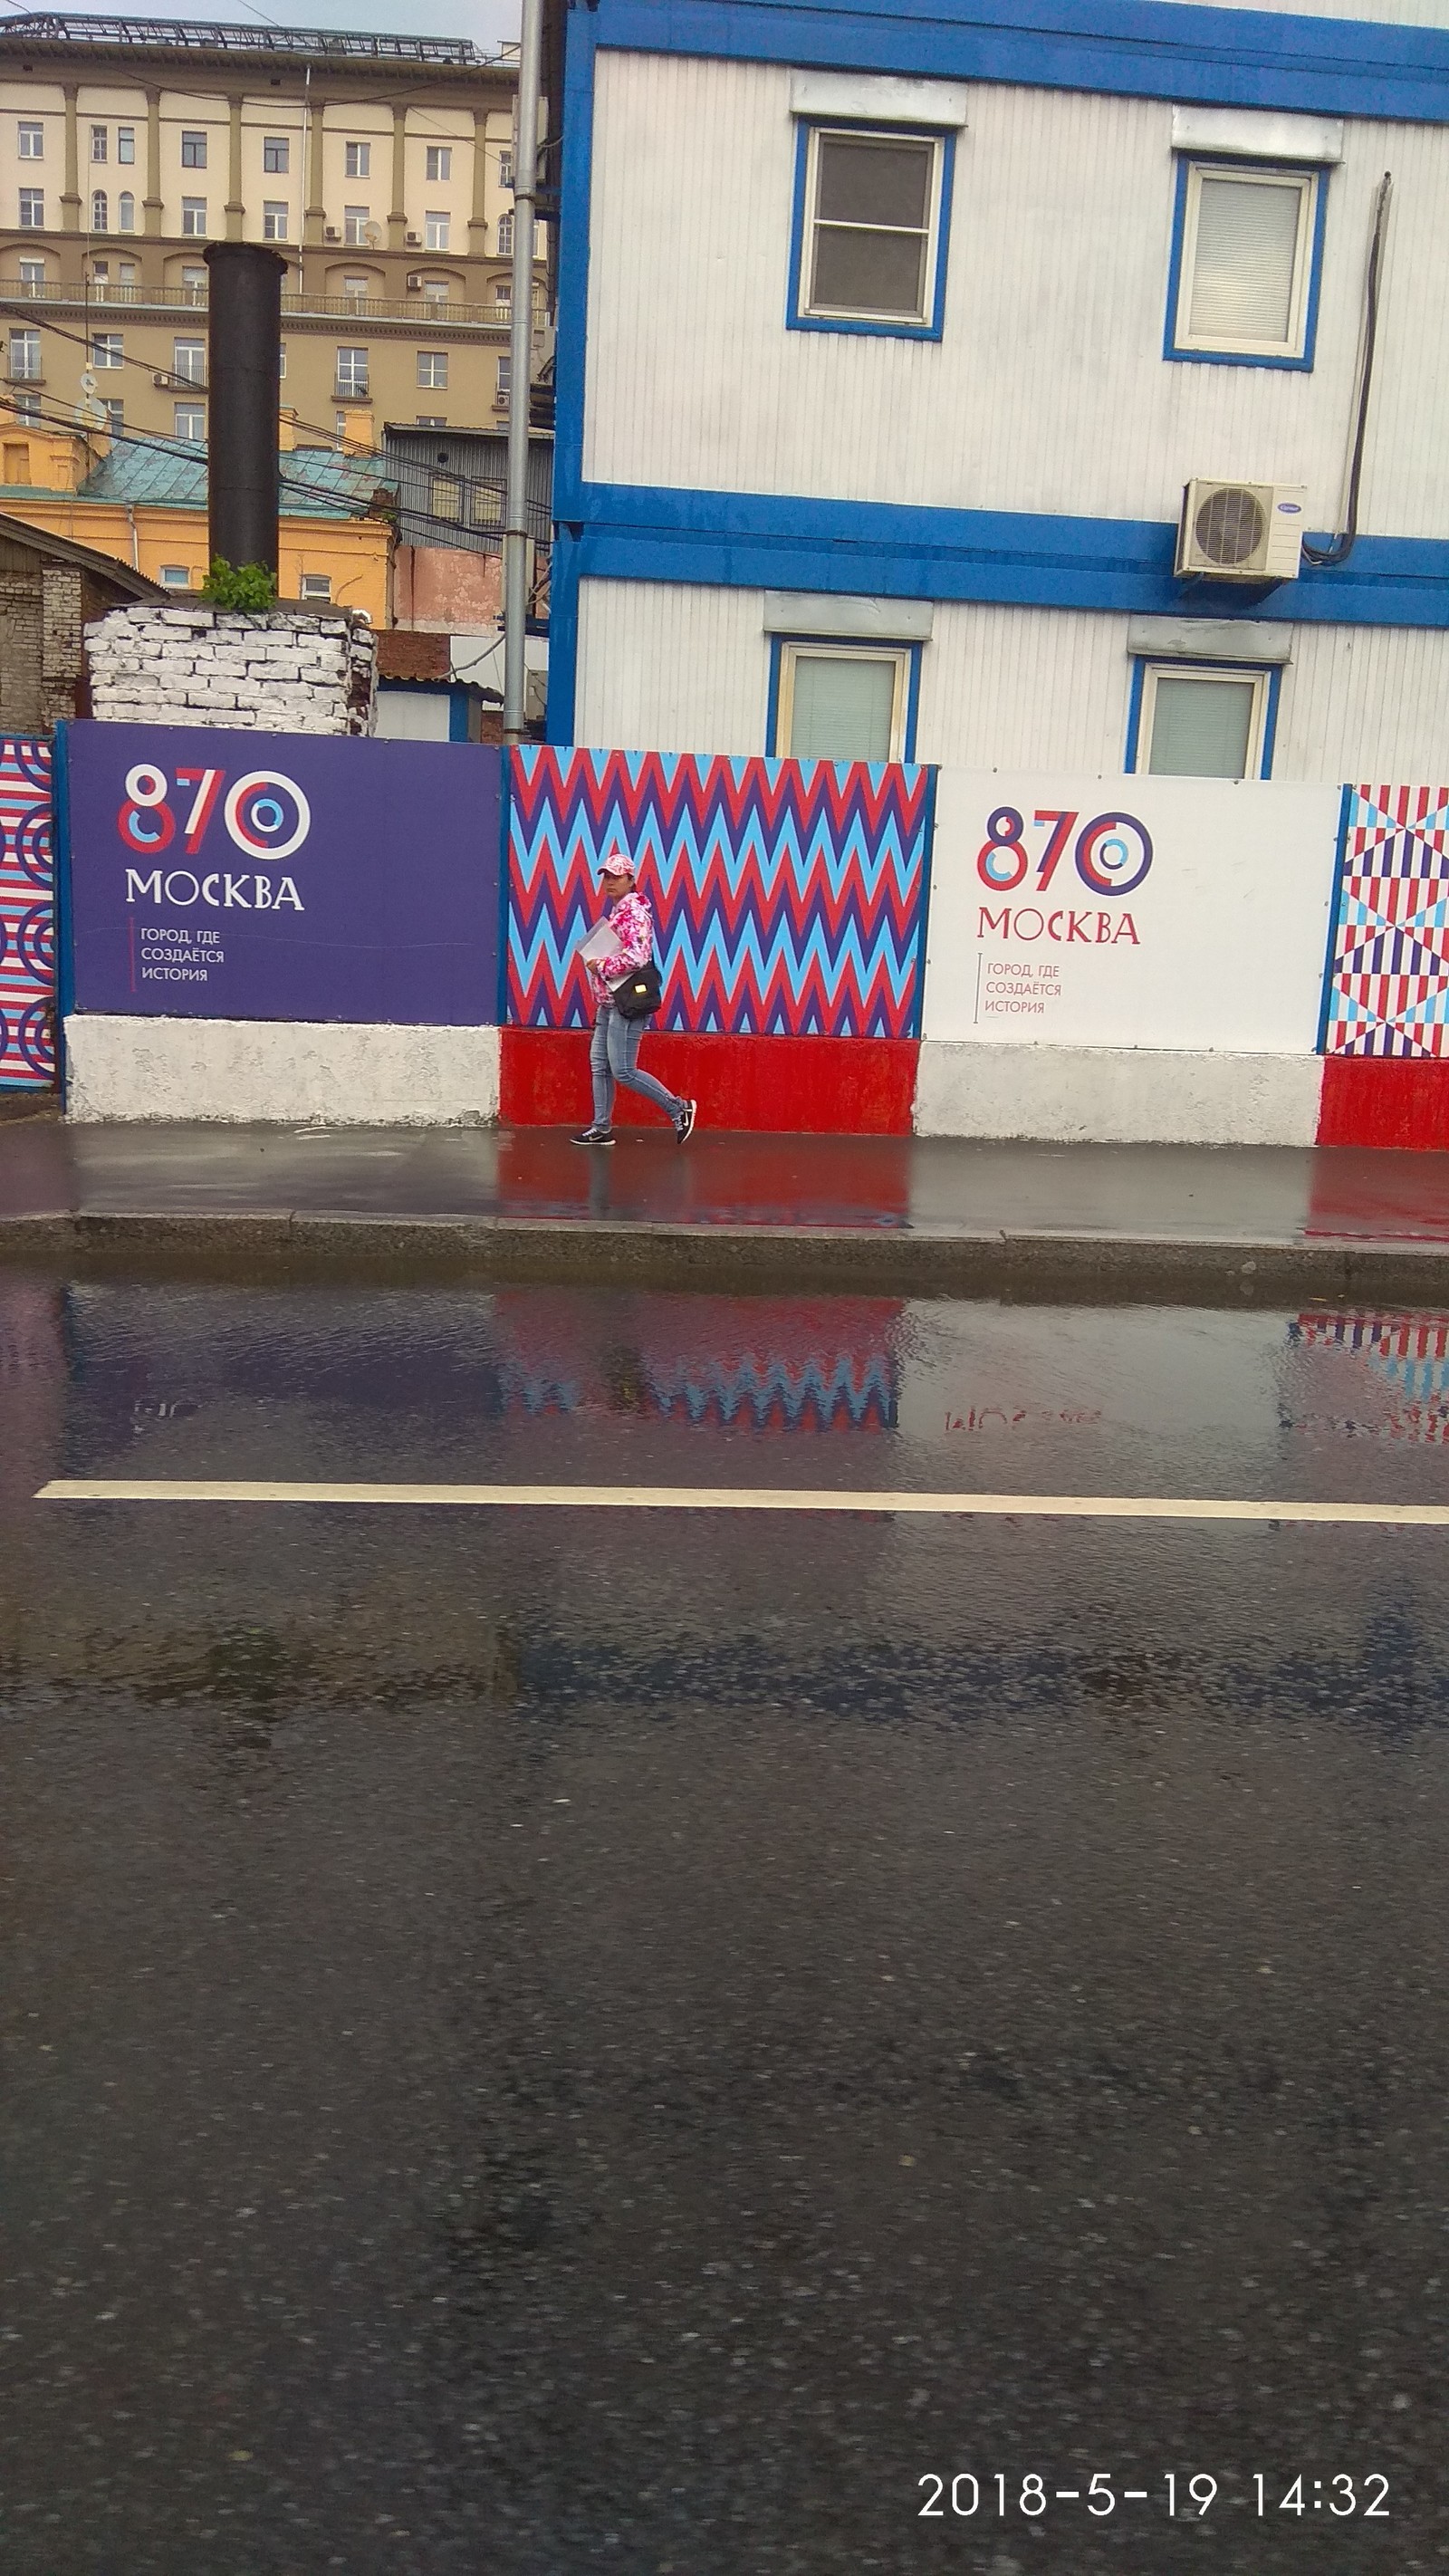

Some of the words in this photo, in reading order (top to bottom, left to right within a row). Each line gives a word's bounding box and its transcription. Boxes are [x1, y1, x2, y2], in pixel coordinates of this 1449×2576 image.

[118, 764, 311, 860] 870
[977, 806, 1153, 896] 870
[125, 869, 305, 911] МОСКВА
[977, 907, 1140, 945] МОСКВА
[140, 928, 192, 945] ГОРОД,
[197, 930, 220, 945] ГДЕ
[140, 947, 225, 963] СОЗДАЁТСЯ
[141, 966, 208, 981] ИСТОРИЯ
[987, 963, 1033, 978] ГОРОД,
[1038, 965, 1060, 978] ГДЕ
[985, 981, 1061, 996] СОЗДАЁТСЯ
[984, 1000, 1045, 1014] ИСТОРИЯ
